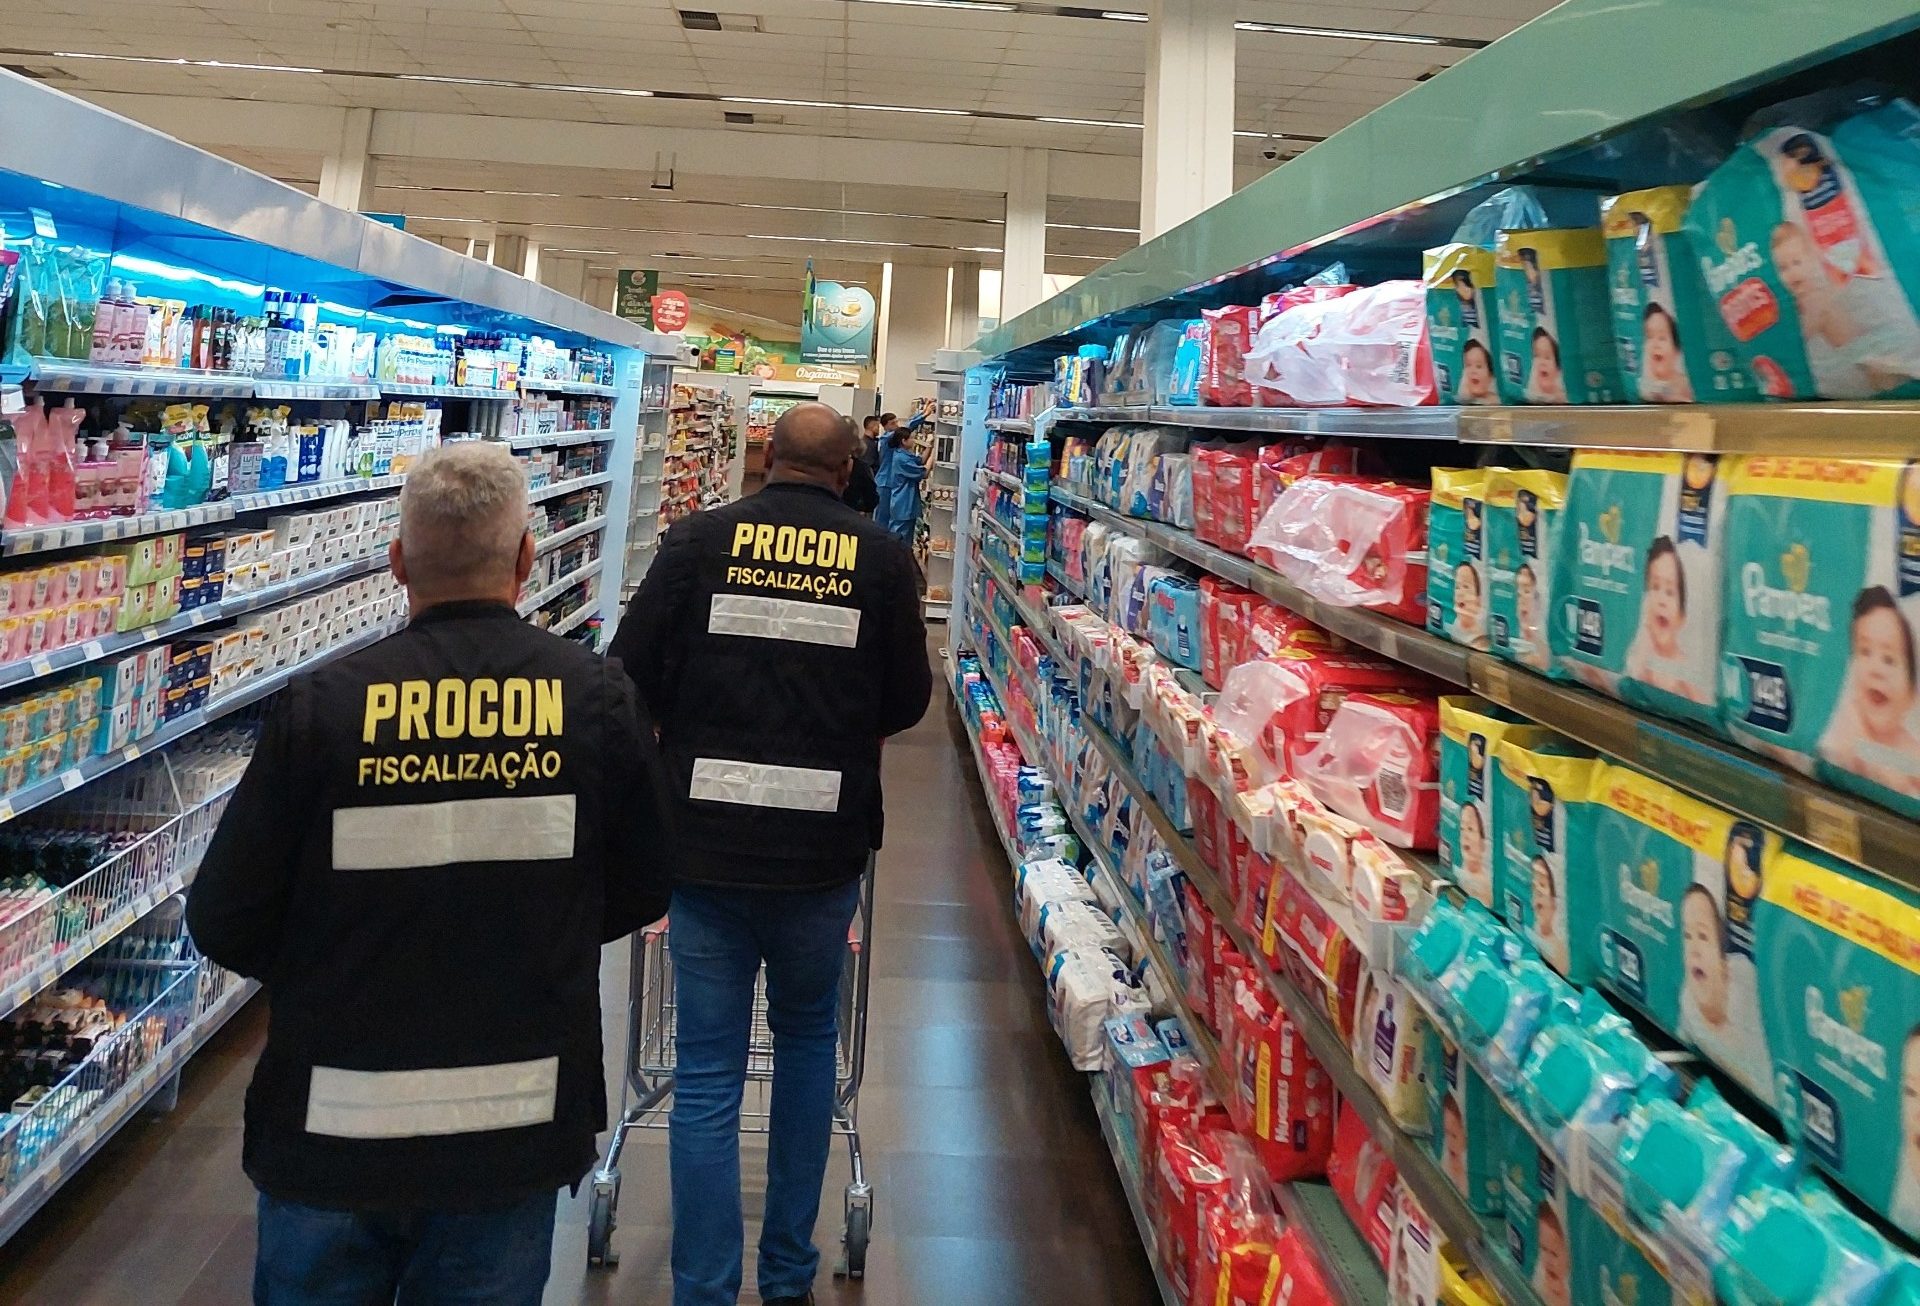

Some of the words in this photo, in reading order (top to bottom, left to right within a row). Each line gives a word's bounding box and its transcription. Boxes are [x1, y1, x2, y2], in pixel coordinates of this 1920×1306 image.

[731, 522, 859, 571] PROCON
[726, 567, 853, 599] FISCALIZAÇÃO
[362, 677, 564, 744] PROCON
[358, 742, 562, 789] FISCALIZAÇÃO
